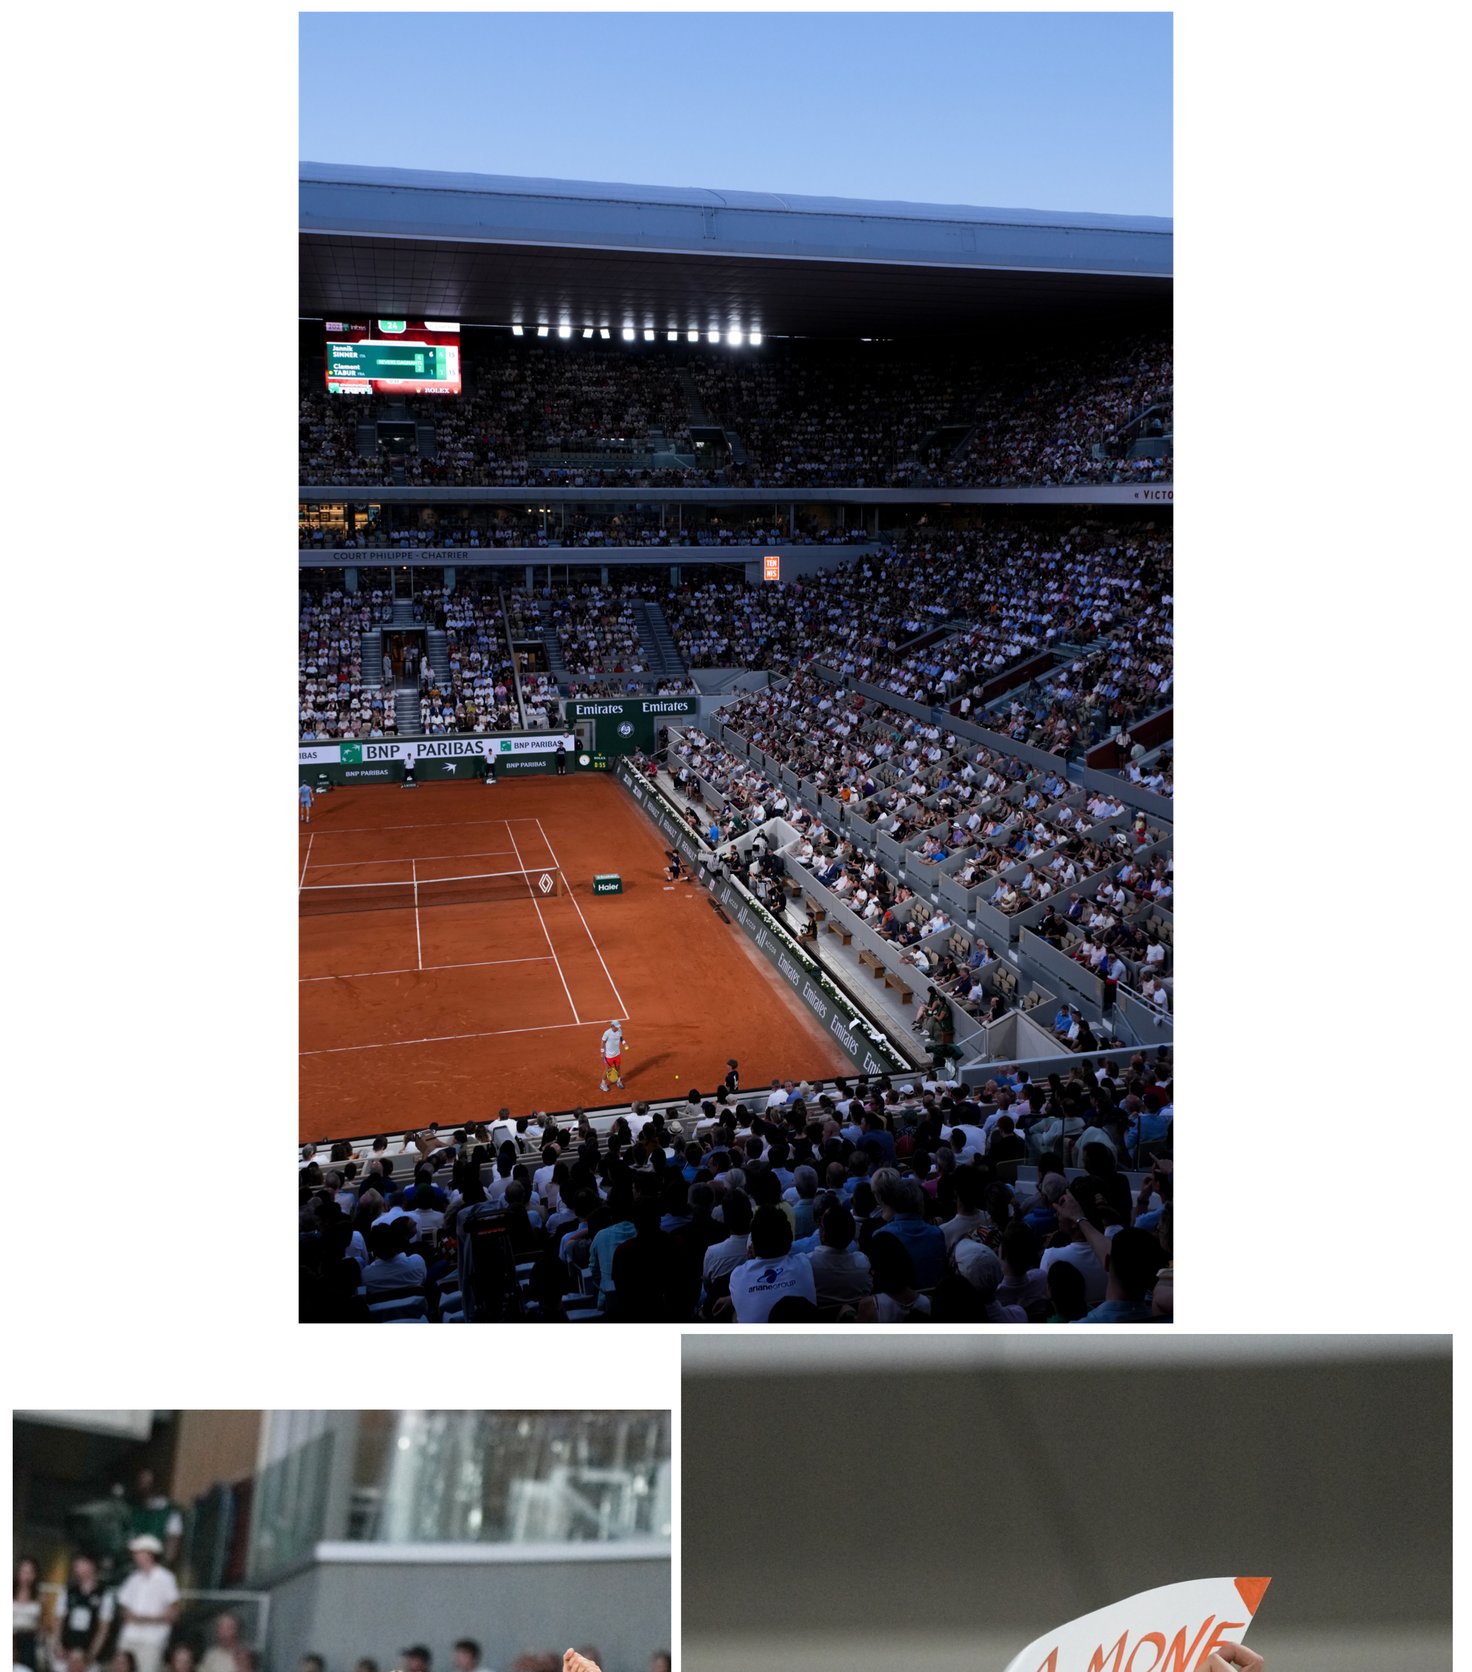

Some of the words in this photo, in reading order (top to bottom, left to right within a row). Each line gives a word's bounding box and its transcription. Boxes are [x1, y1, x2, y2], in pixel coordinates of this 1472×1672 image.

[333, 552, 367, 560] COURT
[370, 552, 413, 560] PHILIPPE
[421, 551, 469, 560] CHATRIER
[576, 703, 623, 715] Emirates
[642, 701, 689, 713] Emirates
[367, 745, 400, 759] BNP
[417, 740, 484, 757] PARIBAS
[514, 741, 529, 749] BNP
[663, 820, 677, 838] RENAULT
[598, 883, 619, 891] Haier
[778, 952, 800, 986] Emirates
[803, 981, 827, 1019] Emirates
[830, 1014, 859, 1055] Emirates
